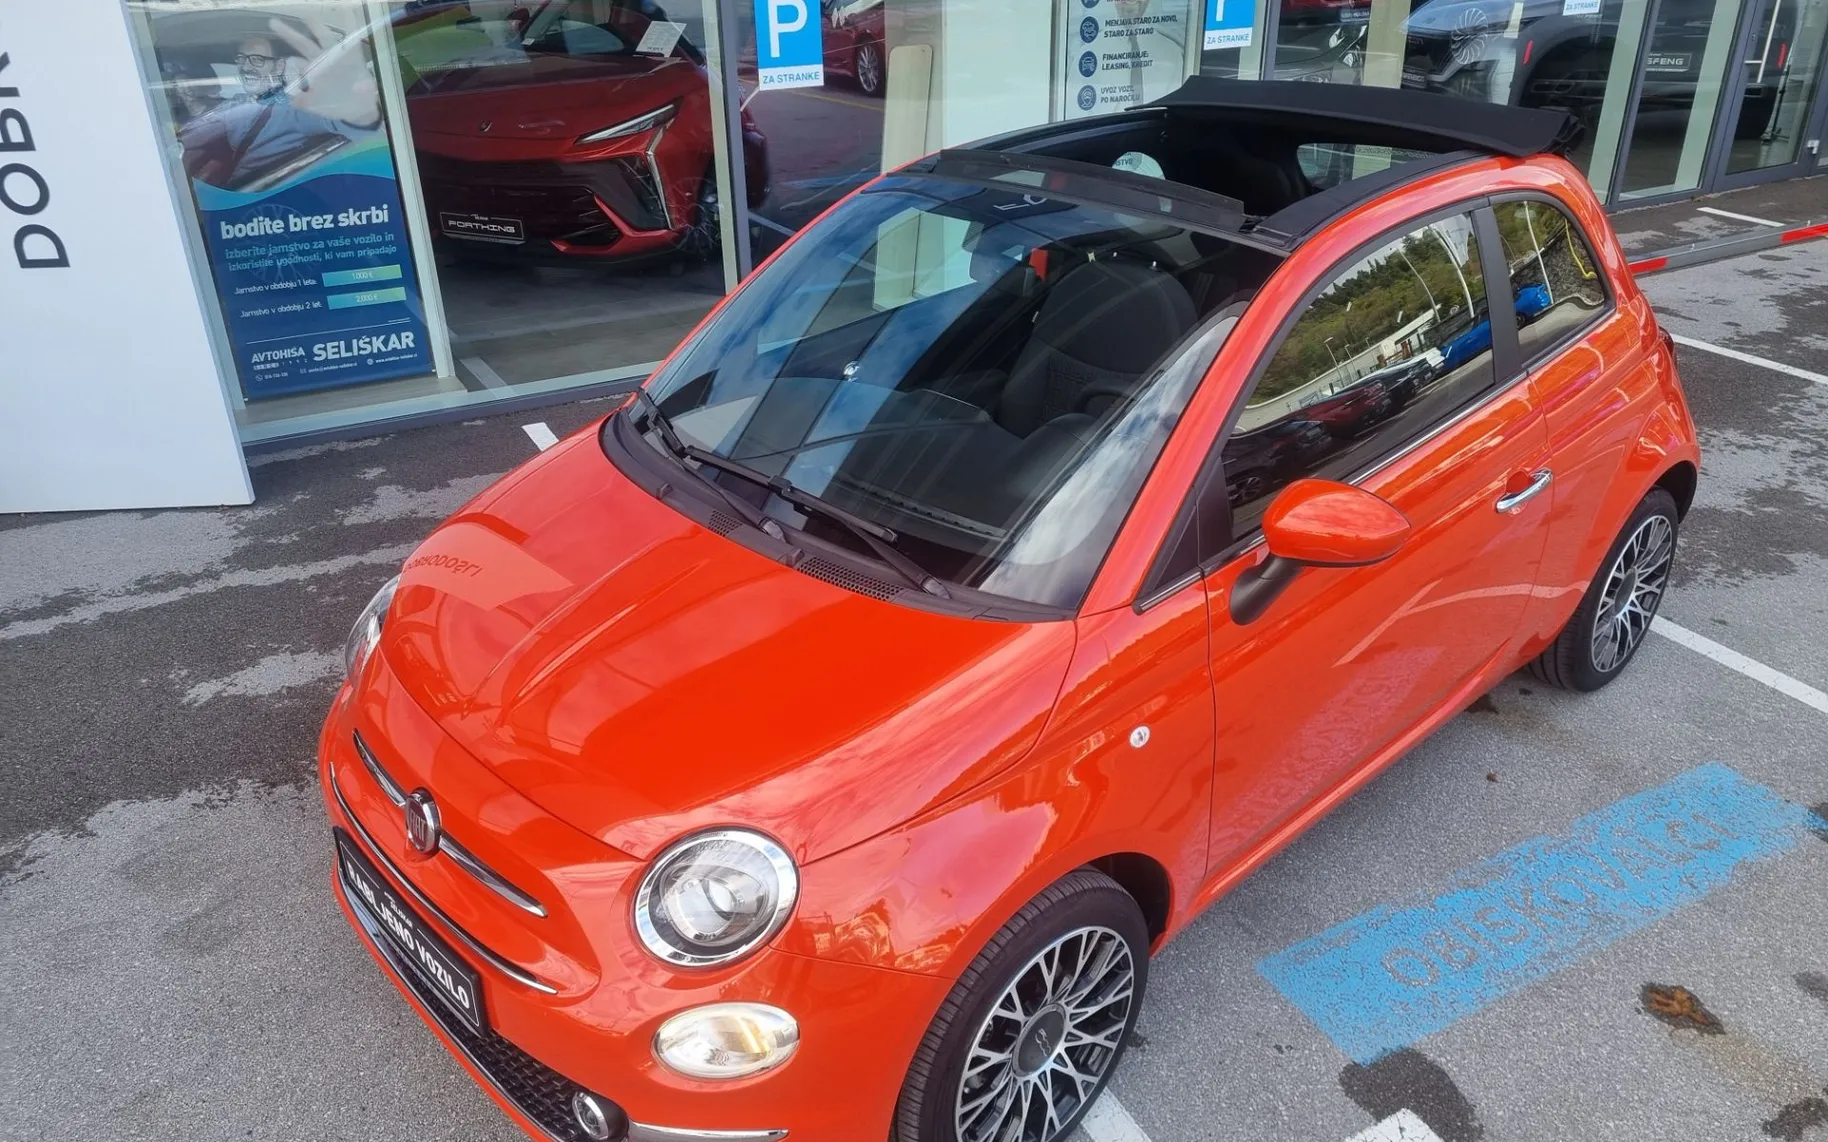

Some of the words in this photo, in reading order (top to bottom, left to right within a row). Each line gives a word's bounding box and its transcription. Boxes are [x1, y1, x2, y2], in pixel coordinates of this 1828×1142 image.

[767, 0, 808, 58] P
[1104, 29, 1125, 38] STARO
[1125, 28, 1134, 37] ZA
[1134, 27, 1154, 36] STARO
[1207, 36, 1216, 44] ZA
[1217, 33, 1250, 43] STRANKE
[762, 75, 776, 84] ZA
[777, 71, 820, 84] STRANKE
[1131, 60, 1154, 69] KREDIT
[1100, 86, 1117, 94] UVOZ
[219, 216, 285, 240] bodite
[288, 213, 335, 233] brez
[338, 204, 389, 227] skrbi
[225, 244, 266, 260] izberite
[267, 241, 311, 259] jamstvo
[312, 239, 325, 249] za
[327, 235, 351, 248] vaše
[353, 232, 382, 245] vozilo
[385, 232, 394, 241] in
[228, 257, 274, 272] izkoristite
[276, 252, 322, 267] ugodnosti,
[325, 251, 333, 261] ki
[335, 251, 355, 260] vam
[357, 244, 397, 258] pripadajo
[234, 285, 264, 295] Jamstvo
[270, 280, 297, 291] obdobju
[240, 308, 270, 318] Jamstvo
[278, 302, 305, 312] obdobju
[305, 301, 311, 310] 2
[251, 347, 306, 363] AVTOHIŠA
[312, 331, 415, 362] SELIŠKAR
[409, 810, 426, 842] FIAT
[1382, 813, 1741, 987] OBISKOVALCI
[346, 860, 415, 951] RABLJENO
[415, 938, 470, 1009] VOZILO
